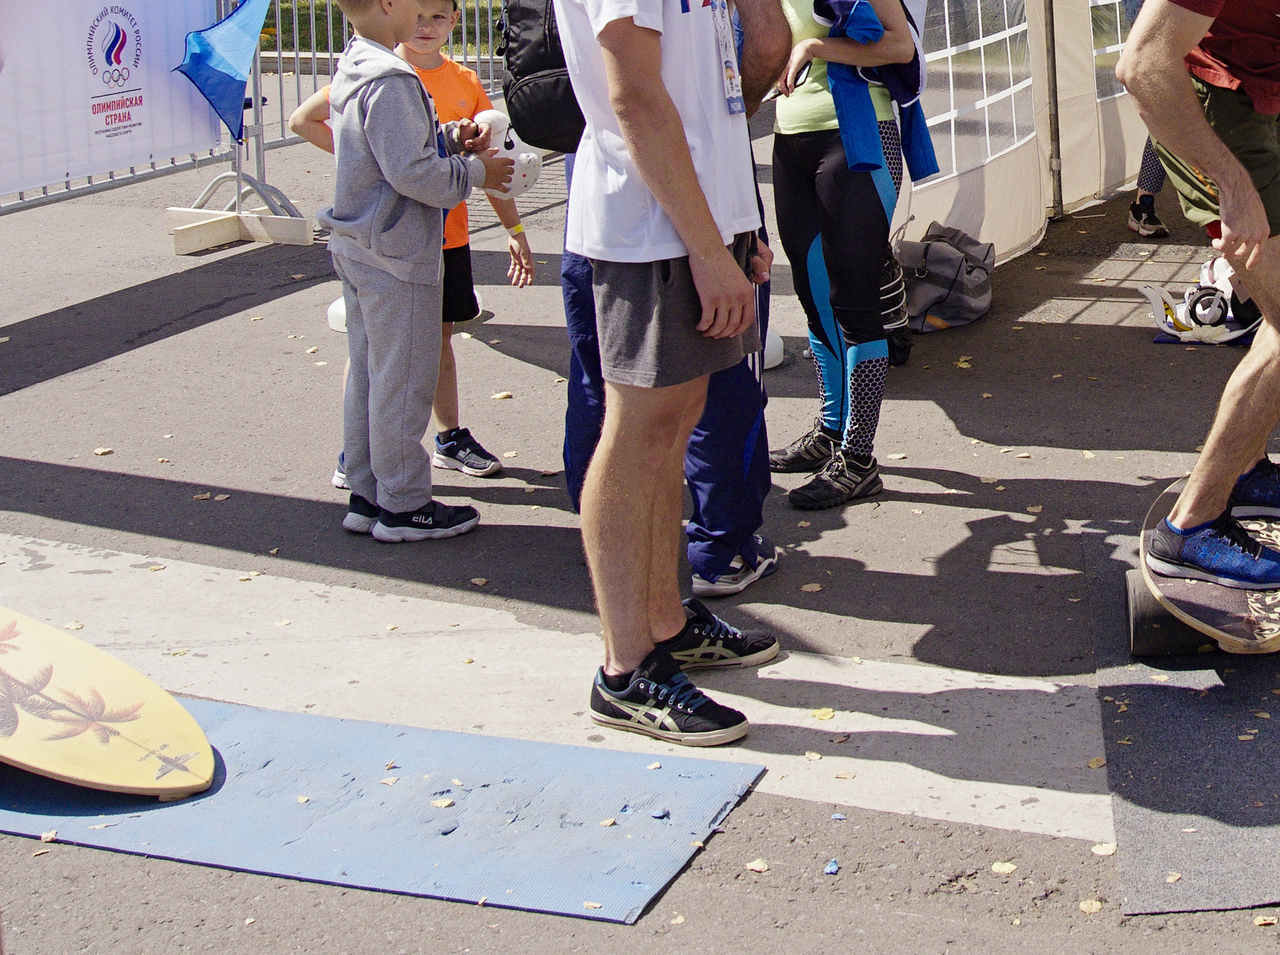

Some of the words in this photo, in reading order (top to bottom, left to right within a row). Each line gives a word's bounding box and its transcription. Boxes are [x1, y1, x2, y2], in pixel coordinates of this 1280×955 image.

[86, 6, 110, 76] ОЛИМПИЙСКИЙ
[110, 5, 138, 28] КОМИТЕТ
[134, 28, 142, 69] РОССИИ
[91, 95, 143, 115] ОЛИМПИЙСКАЯ
[104, 111, 132, 126] СТРАНА
